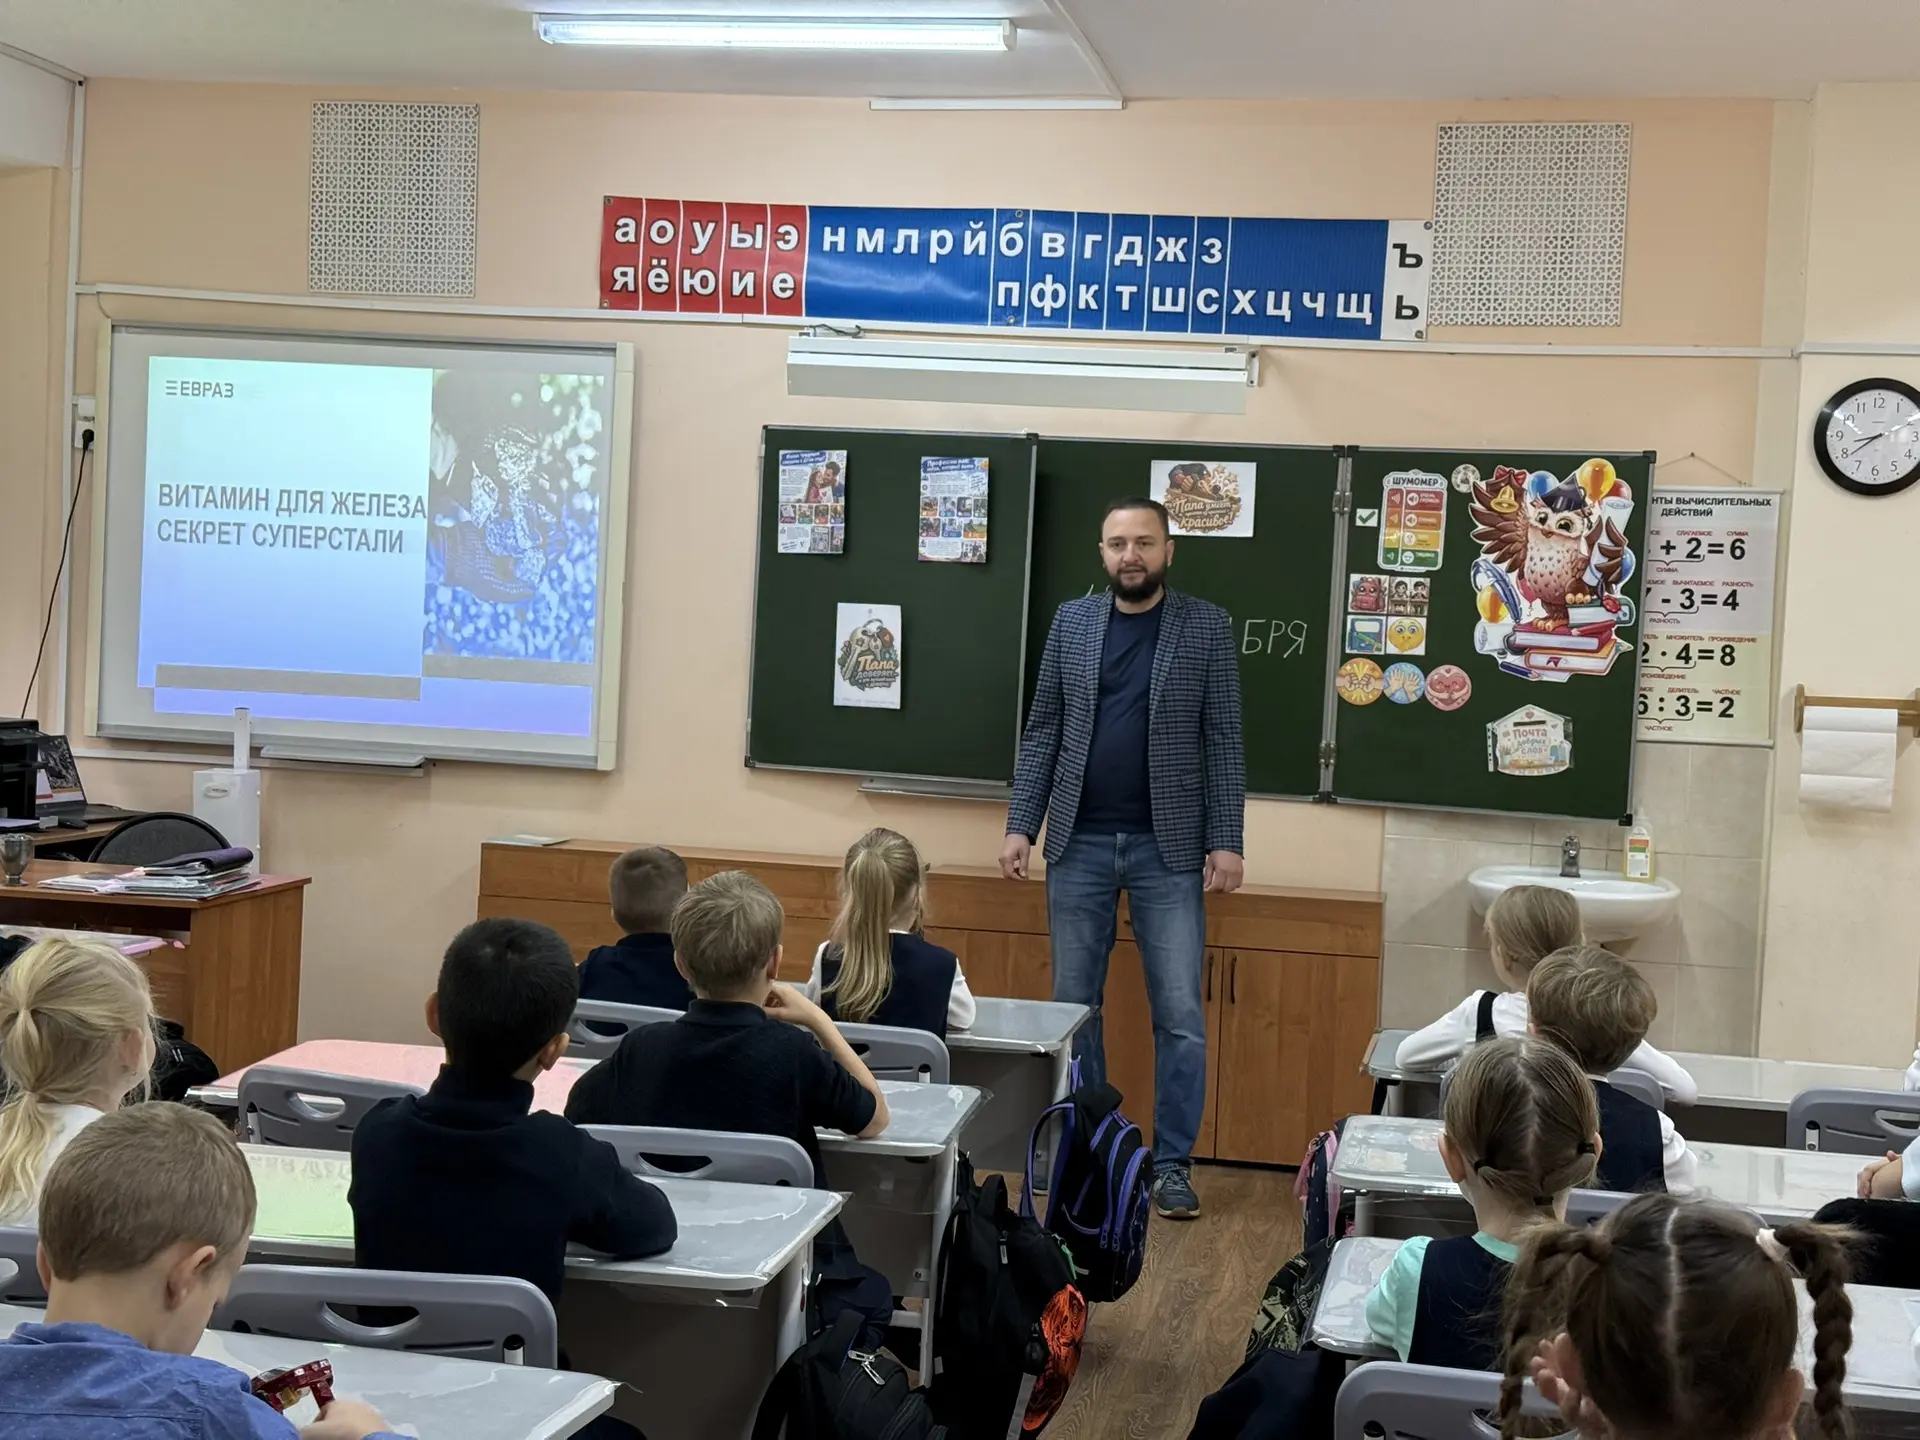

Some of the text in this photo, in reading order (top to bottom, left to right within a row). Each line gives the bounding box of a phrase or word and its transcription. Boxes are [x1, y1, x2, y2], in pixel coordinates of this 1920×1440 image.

[180, 381, 234, 399] ЕВРАЗ
[1856, 402, 1866, 413] 11
[1873, 397, 1885, 409] 12
[1836, 430, 1844, 441] 9
[1911, 431, 1919, 443] 3
[1841, 448, 1849, 459] 8
[1904, 449, 1912, 460] 4
[1854, 460, 1862, 471] 7
[1871, 465, 1879, 477] 6
[1890, 460, 1898, 472] 5
[1392, 477, 1439, 487] ШУМОМЕР
[159, 483, 427, 519] ВИТАМИН ДЛЯ ЖЕЛЕЗА
[1675, 497, 1772, 506] ВЫЧИСЛИТЕЛЬНЫХ
[1661, 507, 1713, 517] ДЕЙСТВИЙ
[157, 518, 403, 553] СЕКРЕТ СУПЕРСТАЛИ
[1229, 616, 1307, 658] БРЯ
[1512, 728, 1548, 740] Почта
